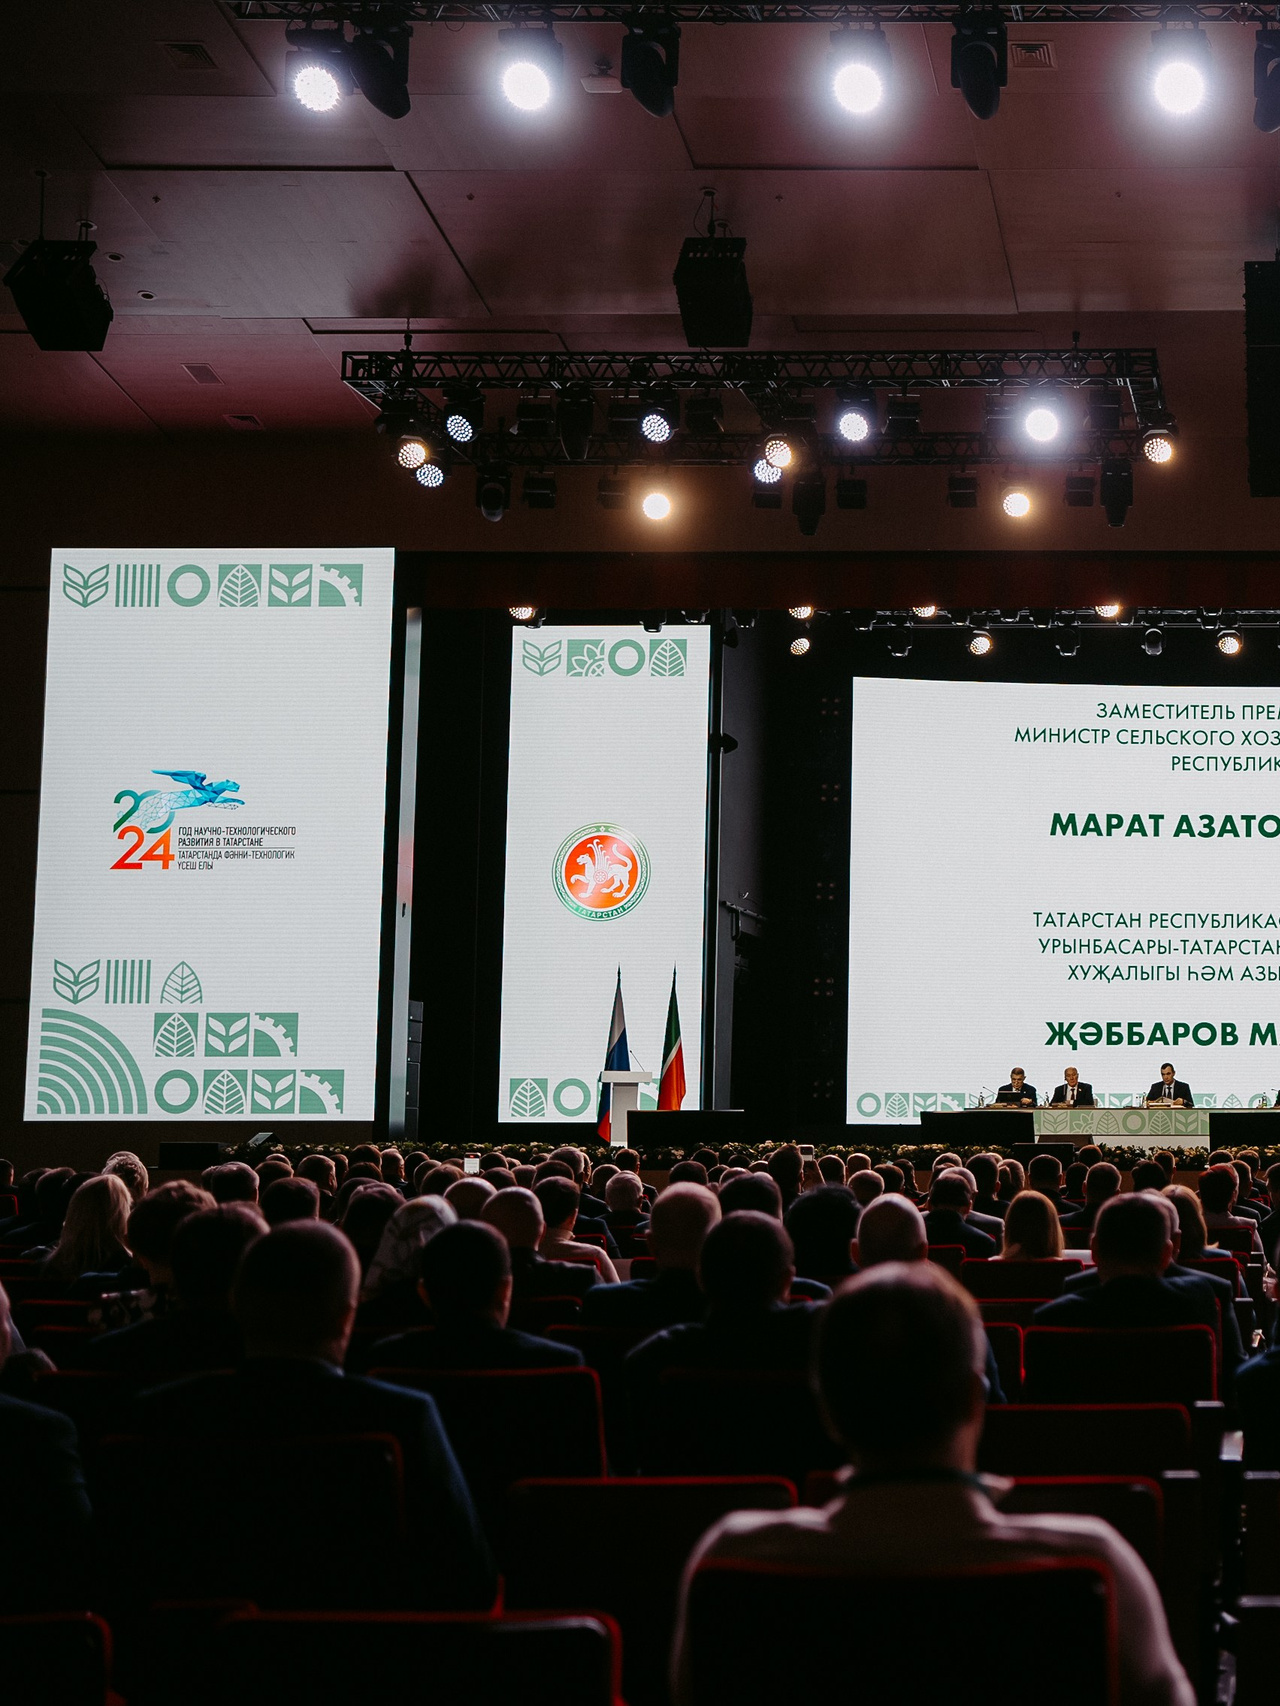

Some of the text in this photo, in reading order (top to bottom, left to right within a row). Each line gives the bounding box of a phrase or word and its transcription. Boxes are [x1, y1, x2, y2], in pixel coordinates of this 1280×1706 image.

[1096, 702, 1236, 720] ЗАМЕСТИТЕЛЬ
[1014, 727, 1111, 745] МИНИСТР
[1115, 729, 1235, 746] СЕЛЬСКОГО
[178, 826, 297, 836] ГОД НАУЧНО-ТЕХНОЛОГИЧЕСКОГО
[1049, 812, 1165, 838] МАРАТ
[110, 825, 175, 870] 24
[178, 837, 264, 847] РАЗВИТИЯ В ТАТАРСТАНЕ
[178, 849, 223, 860] ТАТАРСТАНДА
[198, 861, 214, 871] ЕЛЫ
[578, 906, 624, 918] ТАТАРСТАН
[1032, 911, 1142, 929] ТАТАРСТАН
[1067, 964, 1180, 984] ХУҖАЛЫГЫ
[1043, 1021, 1240, 1052] ҖӘББАРОВ
